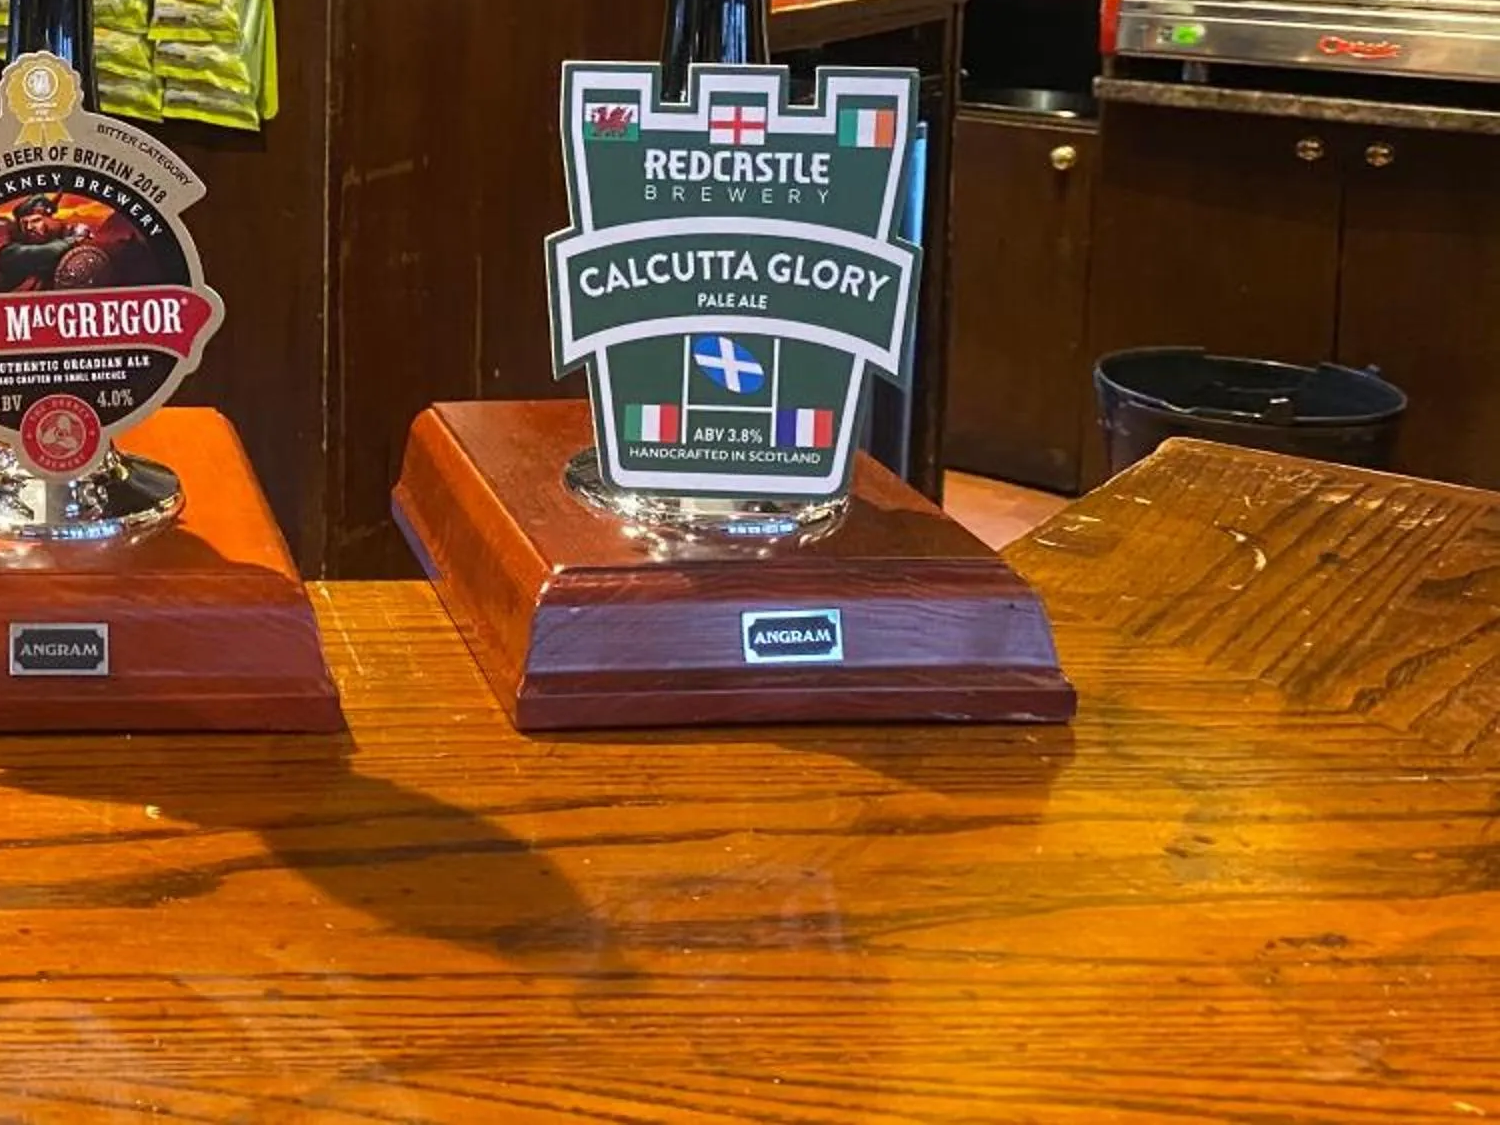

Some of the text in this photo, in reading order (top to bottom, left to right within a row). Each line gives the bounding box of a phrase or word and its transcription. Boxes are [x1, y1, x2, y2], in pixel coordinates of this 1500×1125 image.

[96, 124, 194, 187] BITTER CATEGORY
[2, 146, 44, 169] BEER
[48, 146, 69, 162] OF
[73, 147, 135, 181] BRITAIN
[132, 172, 168, 205] 2018
[643, 148, 831, 185] REDCASTLE
[644, 184, 830, 205] BREWERY
[73, 176, 164, 237] BREWERY
[578, 249, 891, 303] CALCUTTA GLORY
[697, 292, 768, 310] PALE ALE
[63, 356, 123, 370] ORCADIAN
[127, 355, 151, 367] ALE
[96, 388, 134, 408] 4.0%
[693, 427, 764, 444] ABV 3.8%
[628, 446, 821, 464] HANDCRAFTED IN SCOTLAND
[753, 629, 832, 645] ANGRAM
[19, 643, 99, 657] ANGRAM
